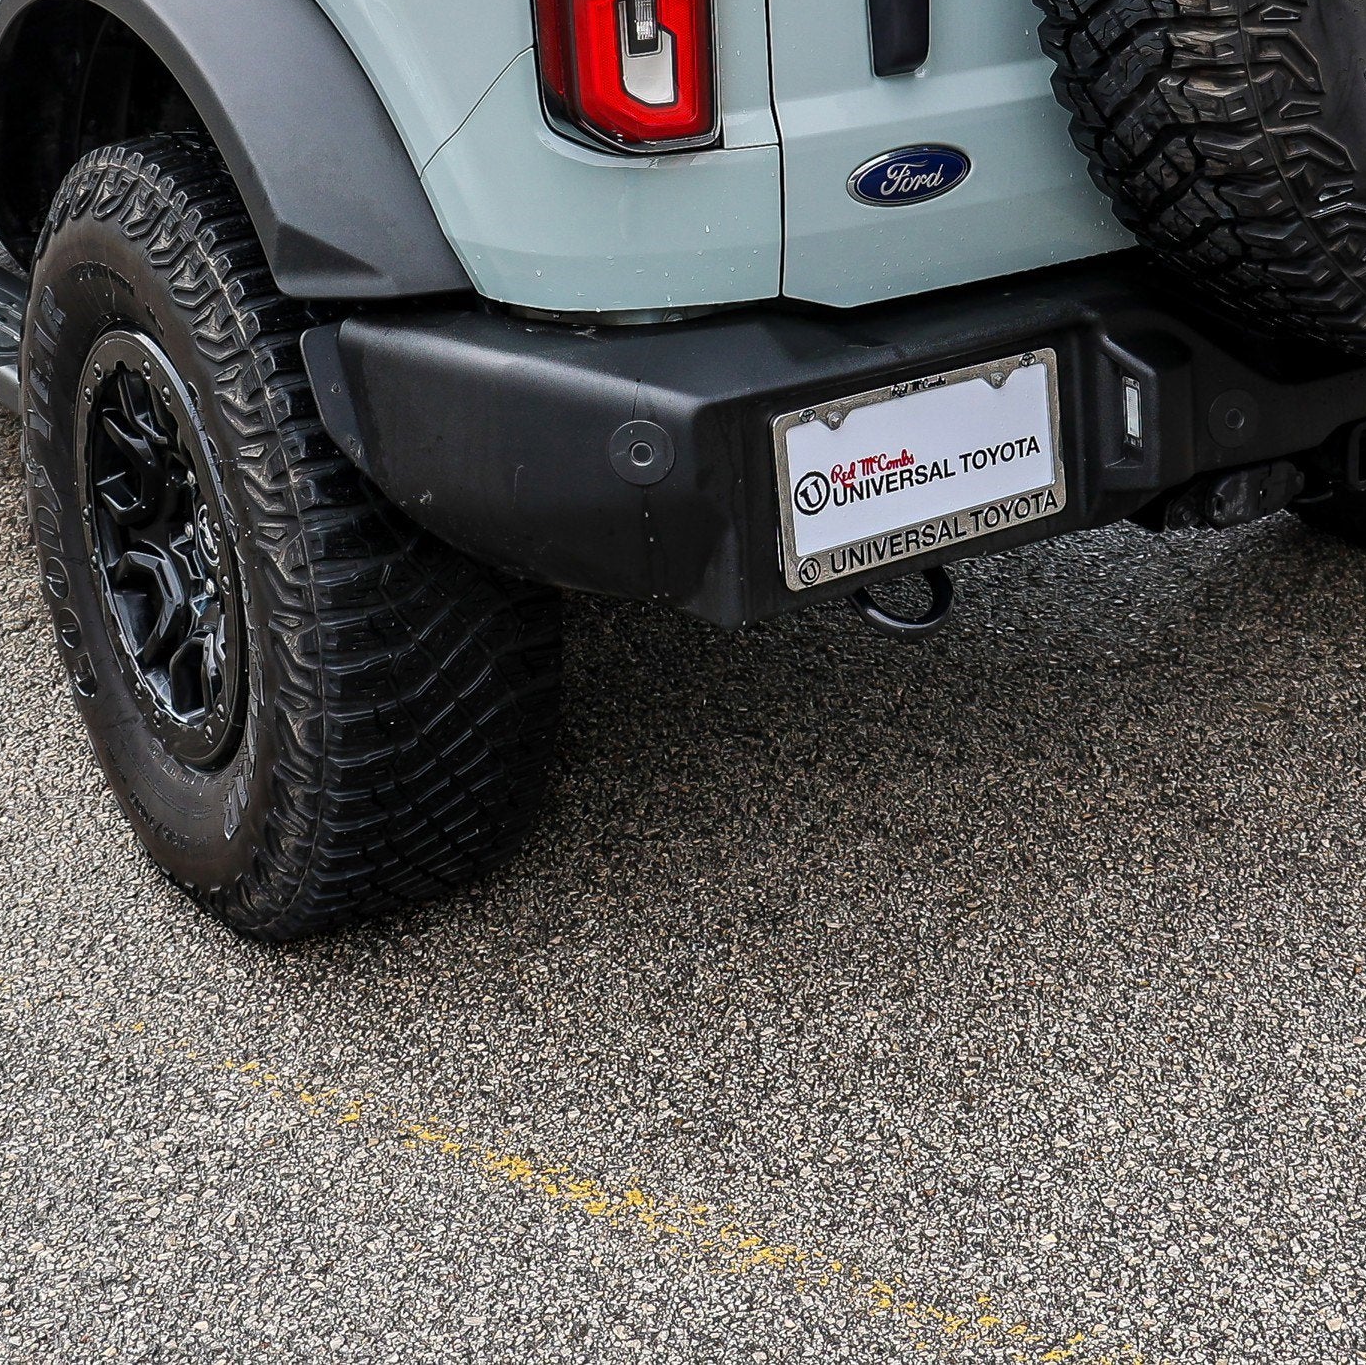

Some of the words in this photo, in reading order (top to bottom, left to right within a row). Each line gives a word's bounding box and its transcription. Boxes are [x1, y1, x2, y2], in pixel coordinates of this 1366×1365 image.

[880, 158, 944, 197] Ford
[831, 461, 856, 488] Red
[857, 448, 915, 477] McCombs
[832, 458, 955, 508] UNIVERSAL
[958, 435, 1040, 472] TOYOTA
[831, 516, 969, 575] UNIVERSAL
[969, 488, 1059, 532] TOYOTA
